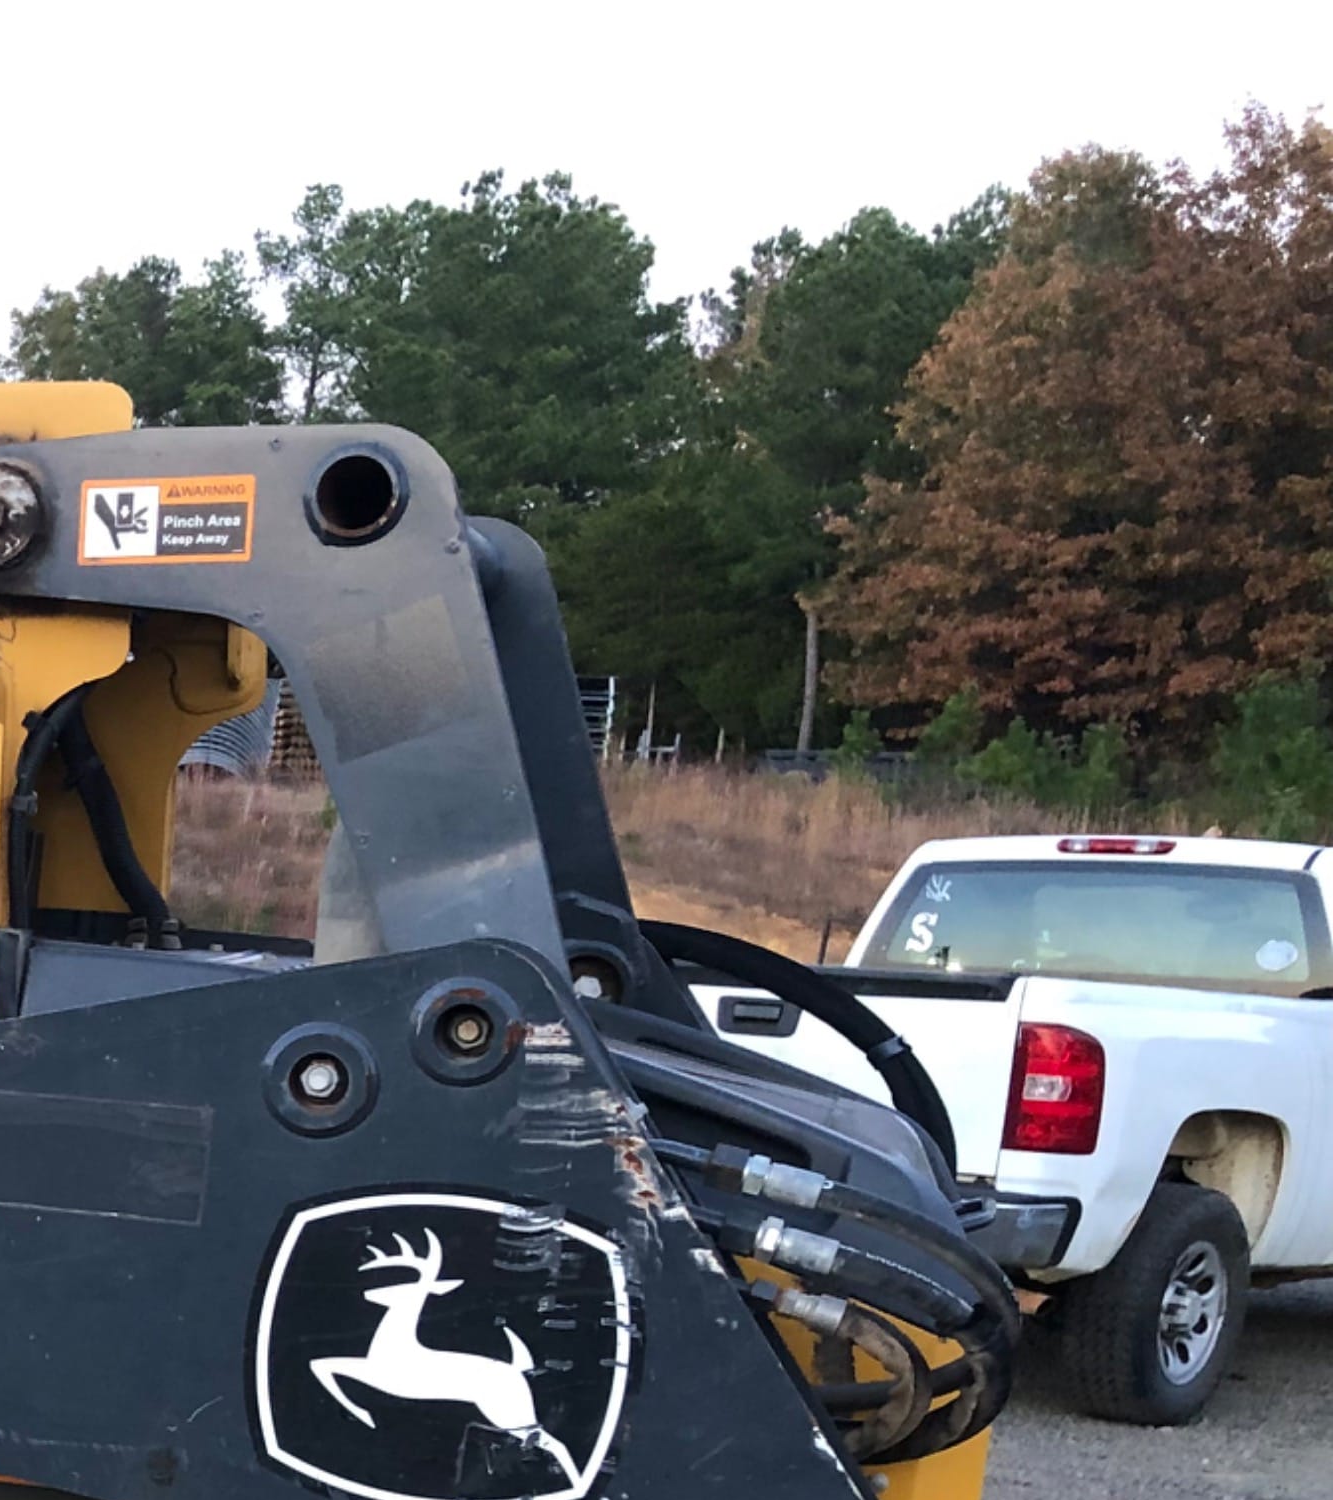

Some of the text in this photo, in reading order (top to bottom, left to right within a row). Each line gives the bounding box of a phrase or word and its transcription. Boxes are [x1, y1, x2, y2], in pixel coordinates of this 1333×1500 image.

[182, 483, 246, 498] WARNING
[163, 513, 242, 529] Pinch Area
[161, 533, 230, 547] Keep Away
